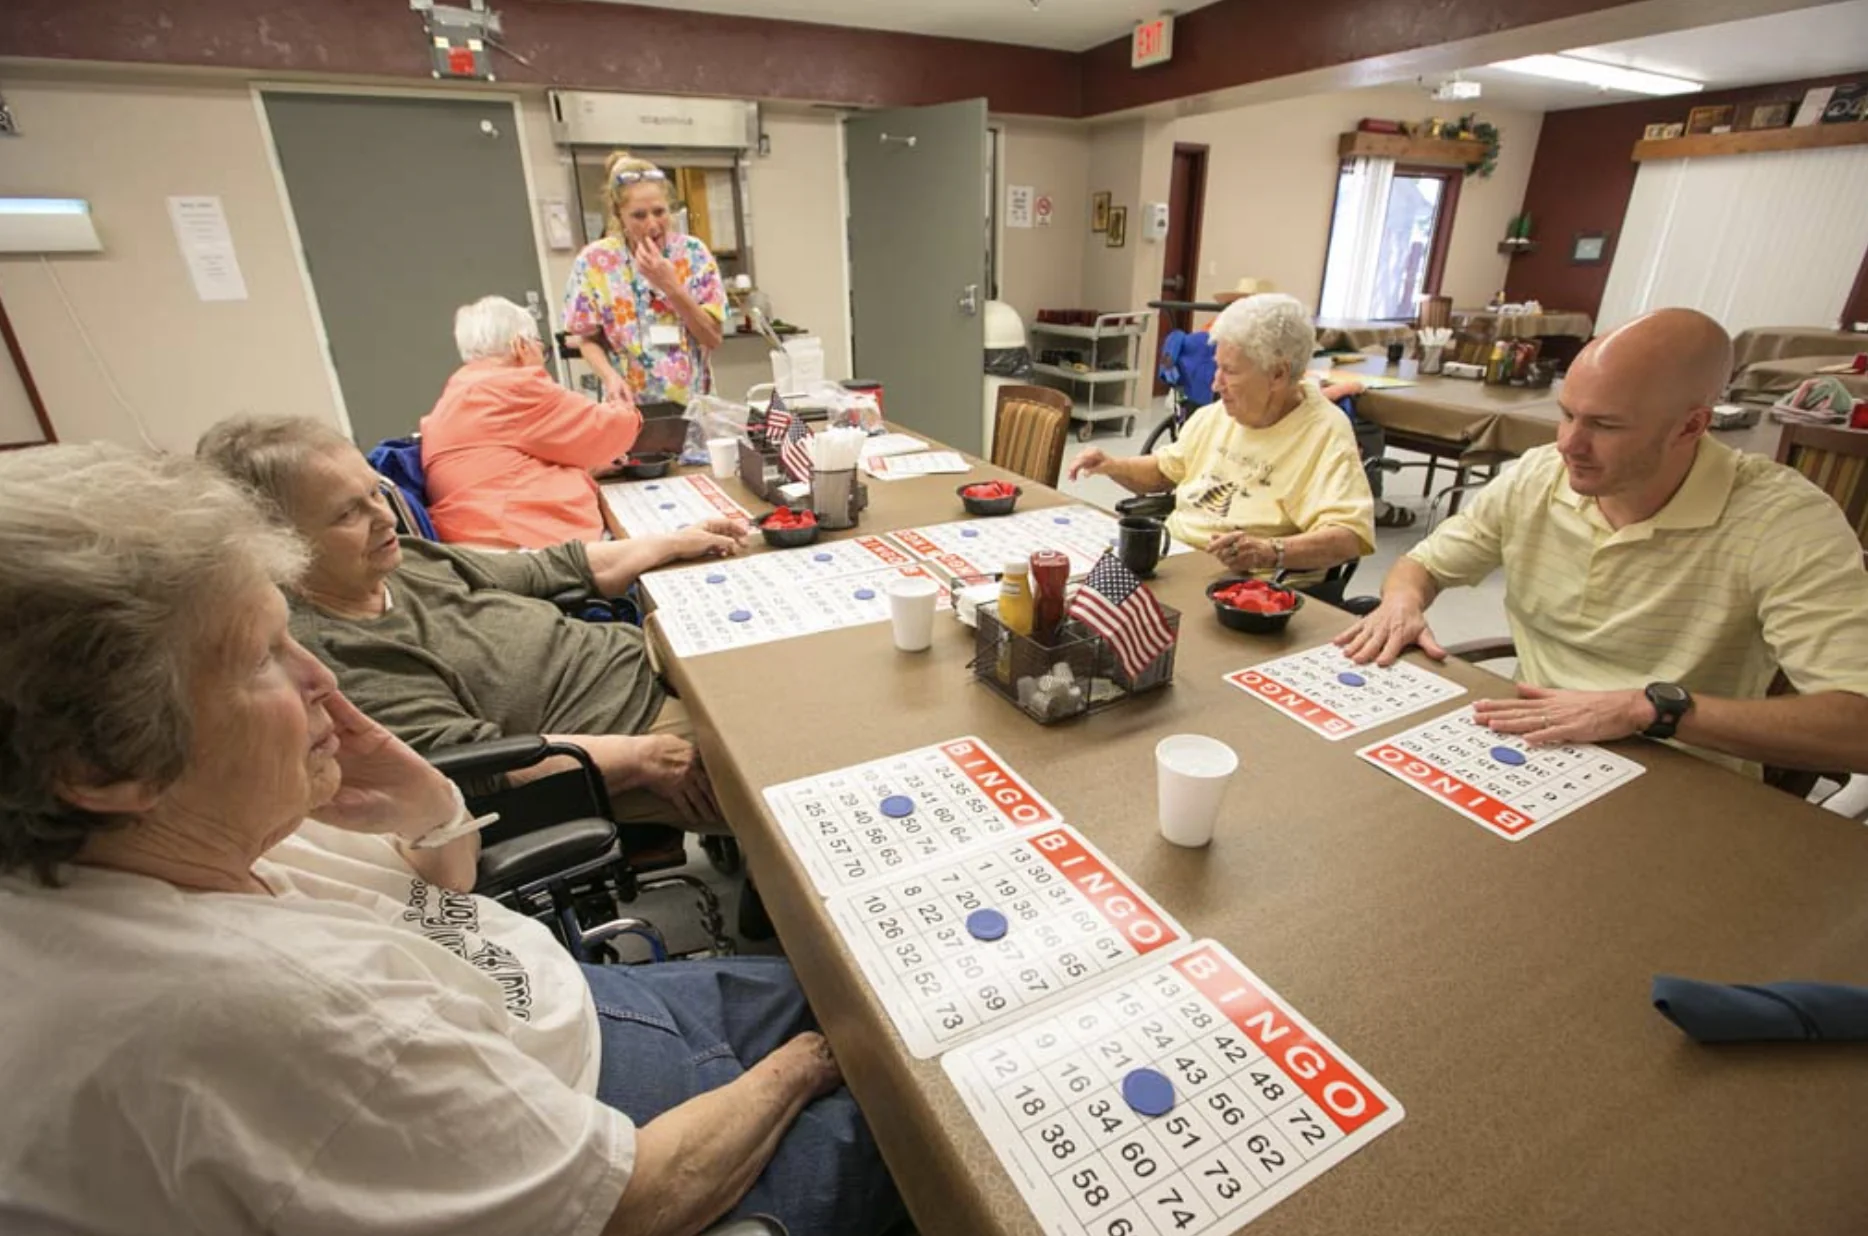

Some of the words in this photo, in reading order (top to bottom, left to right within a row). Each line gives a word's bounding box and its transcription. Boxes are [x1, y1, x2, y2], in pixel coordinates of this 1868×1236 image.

[1137, 21, 1164, 61] EXIT
[1241, 673, 1348, 731] BINGO
[900, 817, 922, 833] 50
[916, 836, 937, 855] 74
[904, 775, 925, 788] 23
[933, 808, 955, 823] 60
[949, 826, 971, 843] 64
[947, 742, 1040, 822] BINGO
[950, 782, 971, 796] 35
[965, 798, 988, 813] 55
[983, 815, 1005, 832] 73
[1379, 748, 1526, 828] BINGO
[805, 802, 826, 817] 25
[819, 821, 838, 836] 42
[829, 839, 852, 854] 57
[844, 859, 866, 878] 70
[854, 810, 873, 824] 40
[865, 828, 888, 845] 56
[880, 848, 902, 866] 63
[1037, 834, 1163, 944] BINGO
[904, 886, 922, 896] 8
[918, 904, 943, 924] 22
[936, 928, 964, 947] 37
[956, 955, 984, 979] 50
[980, 988, 1007, 1011] 69
[943, 873, 960, 884] 7
[955, 891, 981, 910] 20
[1000, 941, 1025, 960] 57
[1020, 969, 1050, 991] 67
[979, 862, 993, 871] 1
[995, 879, 1017, 896] 19
[1013, 900, 1038, 920] 38
[1034, 925, 1062, 948] 56
[1059, 954, 1088, 978] 65
[1010, 848, 1032, 863] 13
[1027, 866, 1052, 883] 30
[1048, 887, 1073, 905] 31
[1071, 911, 1098, 932] 60
[1097, 938, 1123, 959] 61
[864, 896, 887, 913] 10
[878, 917, 904, 939] 26
[896, 943, 922, 967] 32
[914, 971, 941, 996] 52
[937, 1004, 964, 1030] 73
[1116, 992, 1144, 1016] 15
[1142, 1022, 1175, 1049] 24
[1175, 1058, 1208, 1085] 43
[1208, 1093, 1245, 1126] 56
[1247, 1135, 1285, 1173] 62
[1155, 974, 1180, 997] 13
[1180, 1003, 1213, 1029] 28
[1215, 1037, 1247, 1064] 42
[1250, 1072, 1285, 1101] 48
[1289, 1108, 1326, 1145] 72
[1185, 954, 1366, 1116] BINGO
[991, 1050, 1019, 1078] 12
[1015, 1086, 1046, 1116] 18
[1041, 1124, 1076, 1159] 38
[1072, 1169, 1109, 1207] 58
[1107, 1218, 1134, 1236] 6
[1036, 1031, 1057, 1050] 9
[1061, 1064, 1091, 1093] 16
[1088, 1100, 1123, 1133] 34
[1121, 1142, 1157, 1178] 60
[1157, 1188, 1196, 1229] 74
[1078, 1015, 1098, 1030] 6
[1100, 1042, 1133, 1068] 21
[1166, 1117, 1201, 1149] 51
[1204, 1160, 1241, 1199] 73
